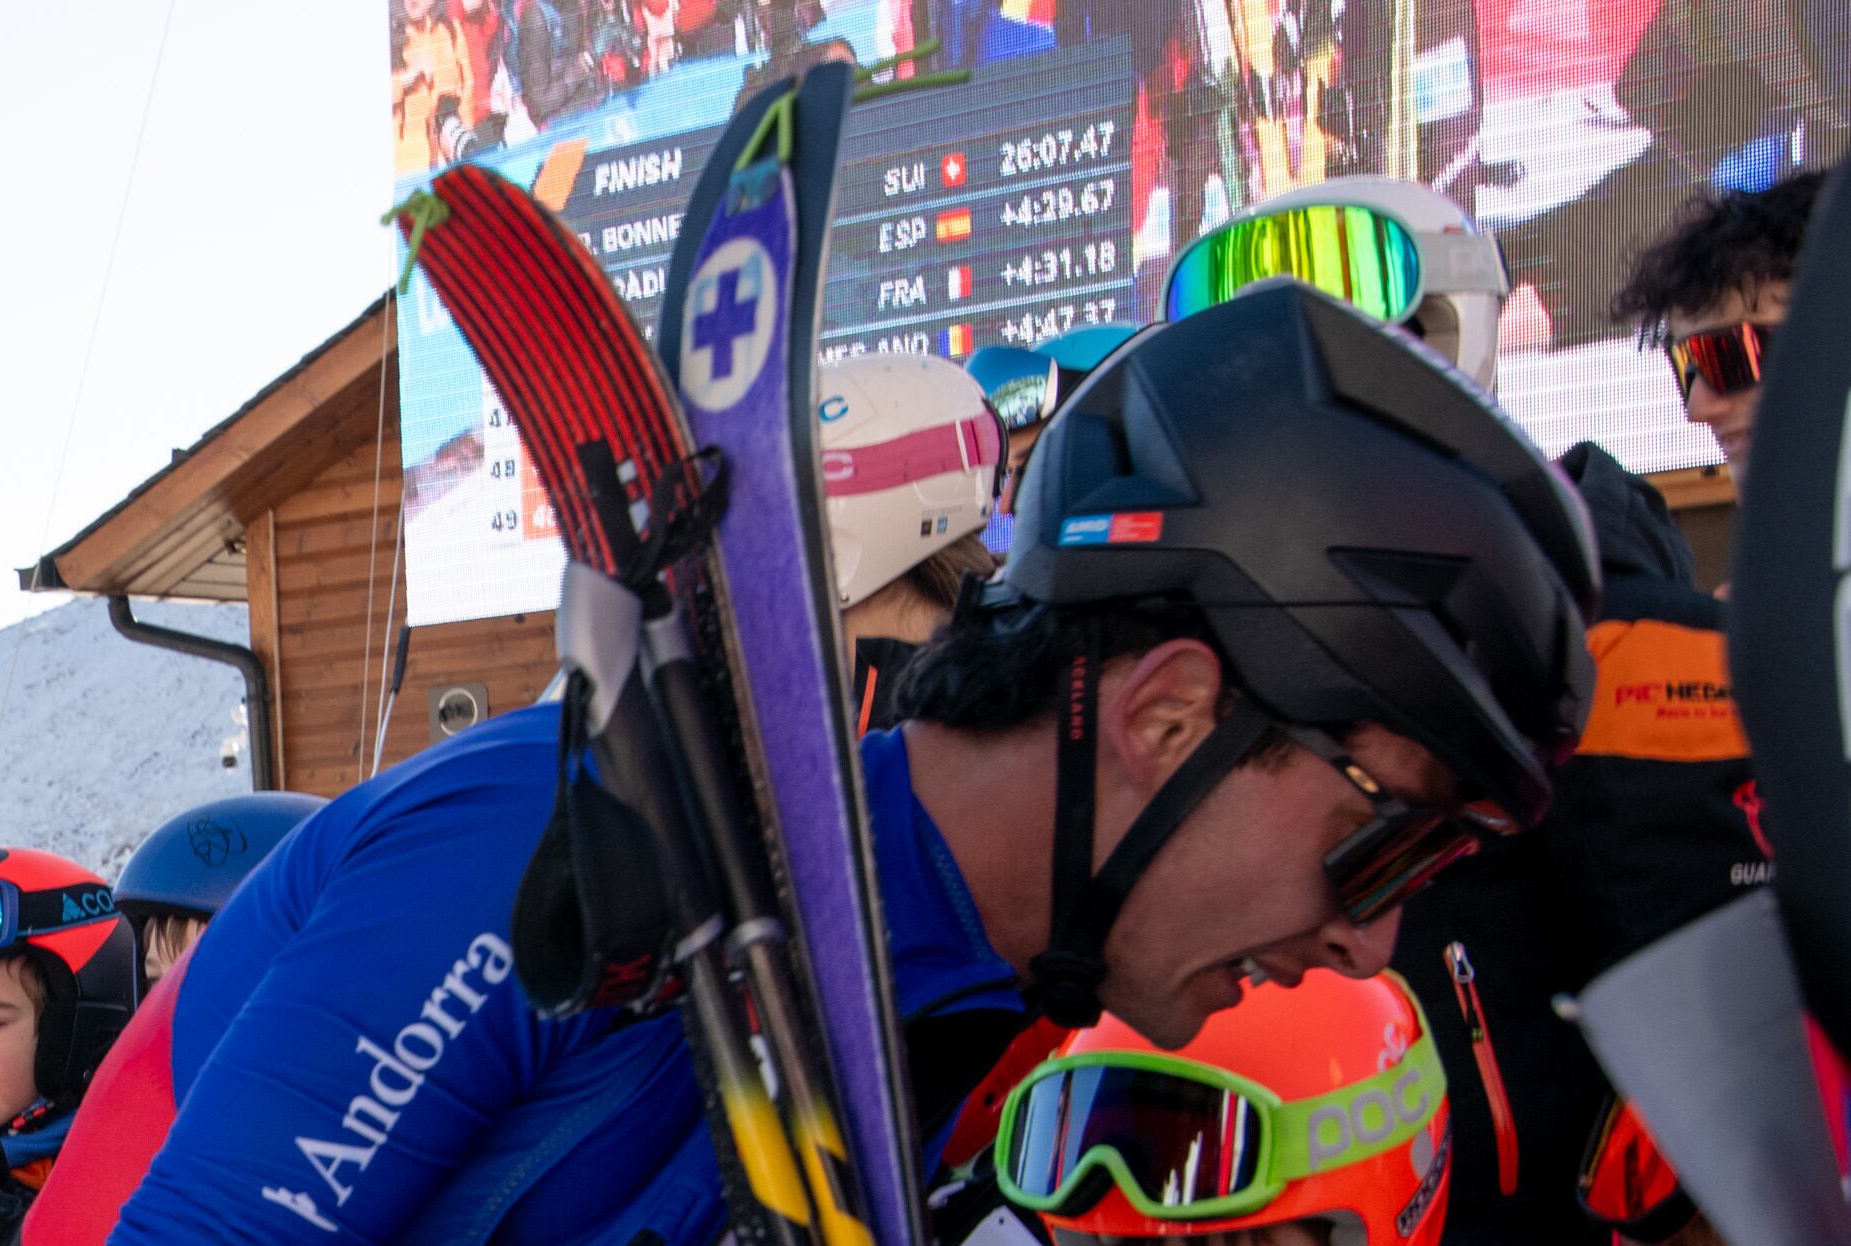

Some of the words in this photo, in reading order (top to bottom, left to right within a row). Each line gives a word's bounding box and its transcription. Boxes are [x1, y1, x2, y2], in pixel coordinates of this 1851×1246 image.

[594, 148, 683, 196] FINISH
[884, 162, 926, 196] SUI
[999, 121, 1114, 177] 26:07.47
[879, 216, 926, 253] ESP
[877, 275, 927, 312] FRA
[1000, 240, 1115, 286] +4:31.18
[294, 932, 515, 1207] Andorra
